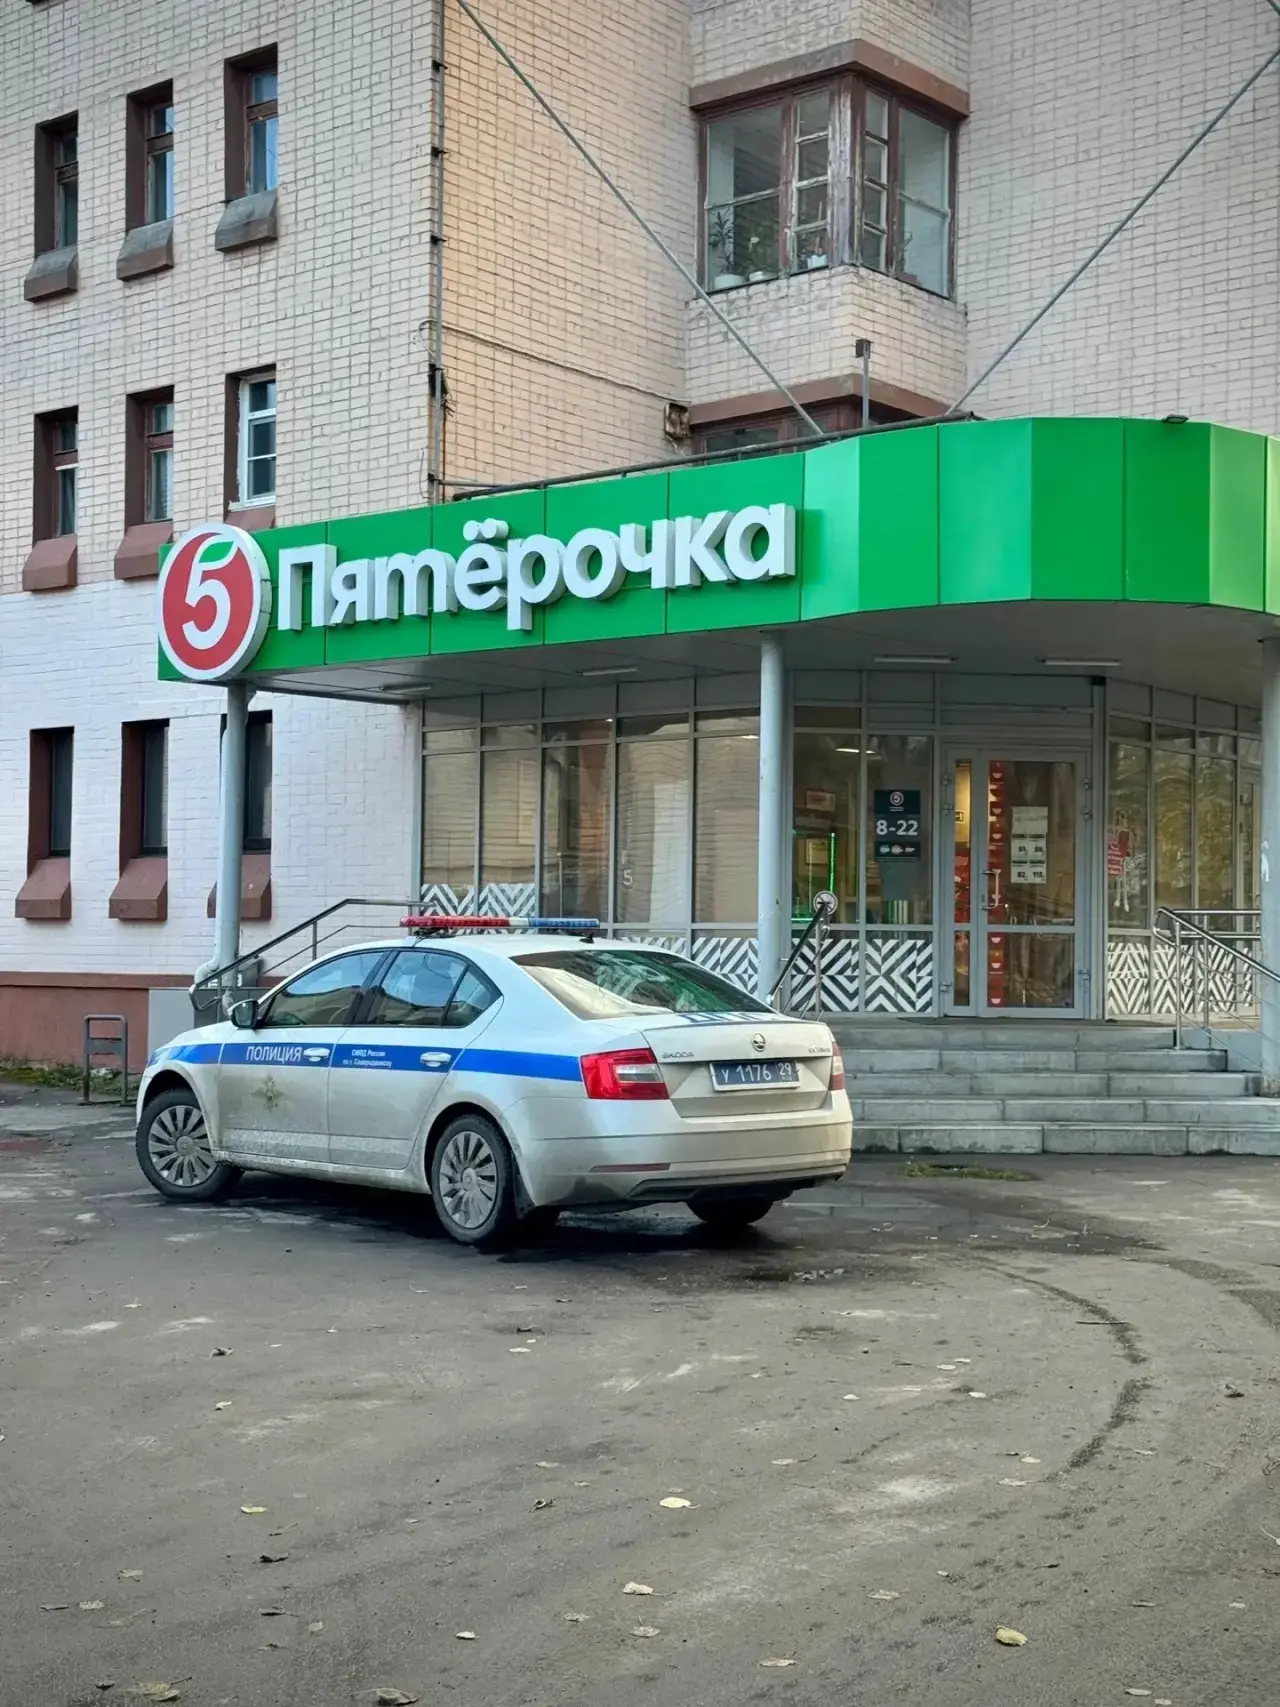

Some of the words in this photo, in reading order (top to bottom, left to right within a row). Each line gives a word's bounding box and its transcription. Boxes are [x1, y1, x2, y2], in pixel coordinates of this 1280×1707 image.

[182, 540, 235, 650] 5
[277, 503, 796, 631] Пятёрочка
[876, 820, 919, 835] 8-22
[246, 1046, 302, 1064] ПОЛИЦИЯ
[736, 1064, 772, 1082] 1176
[778, 1062, 792, 1076] 29
